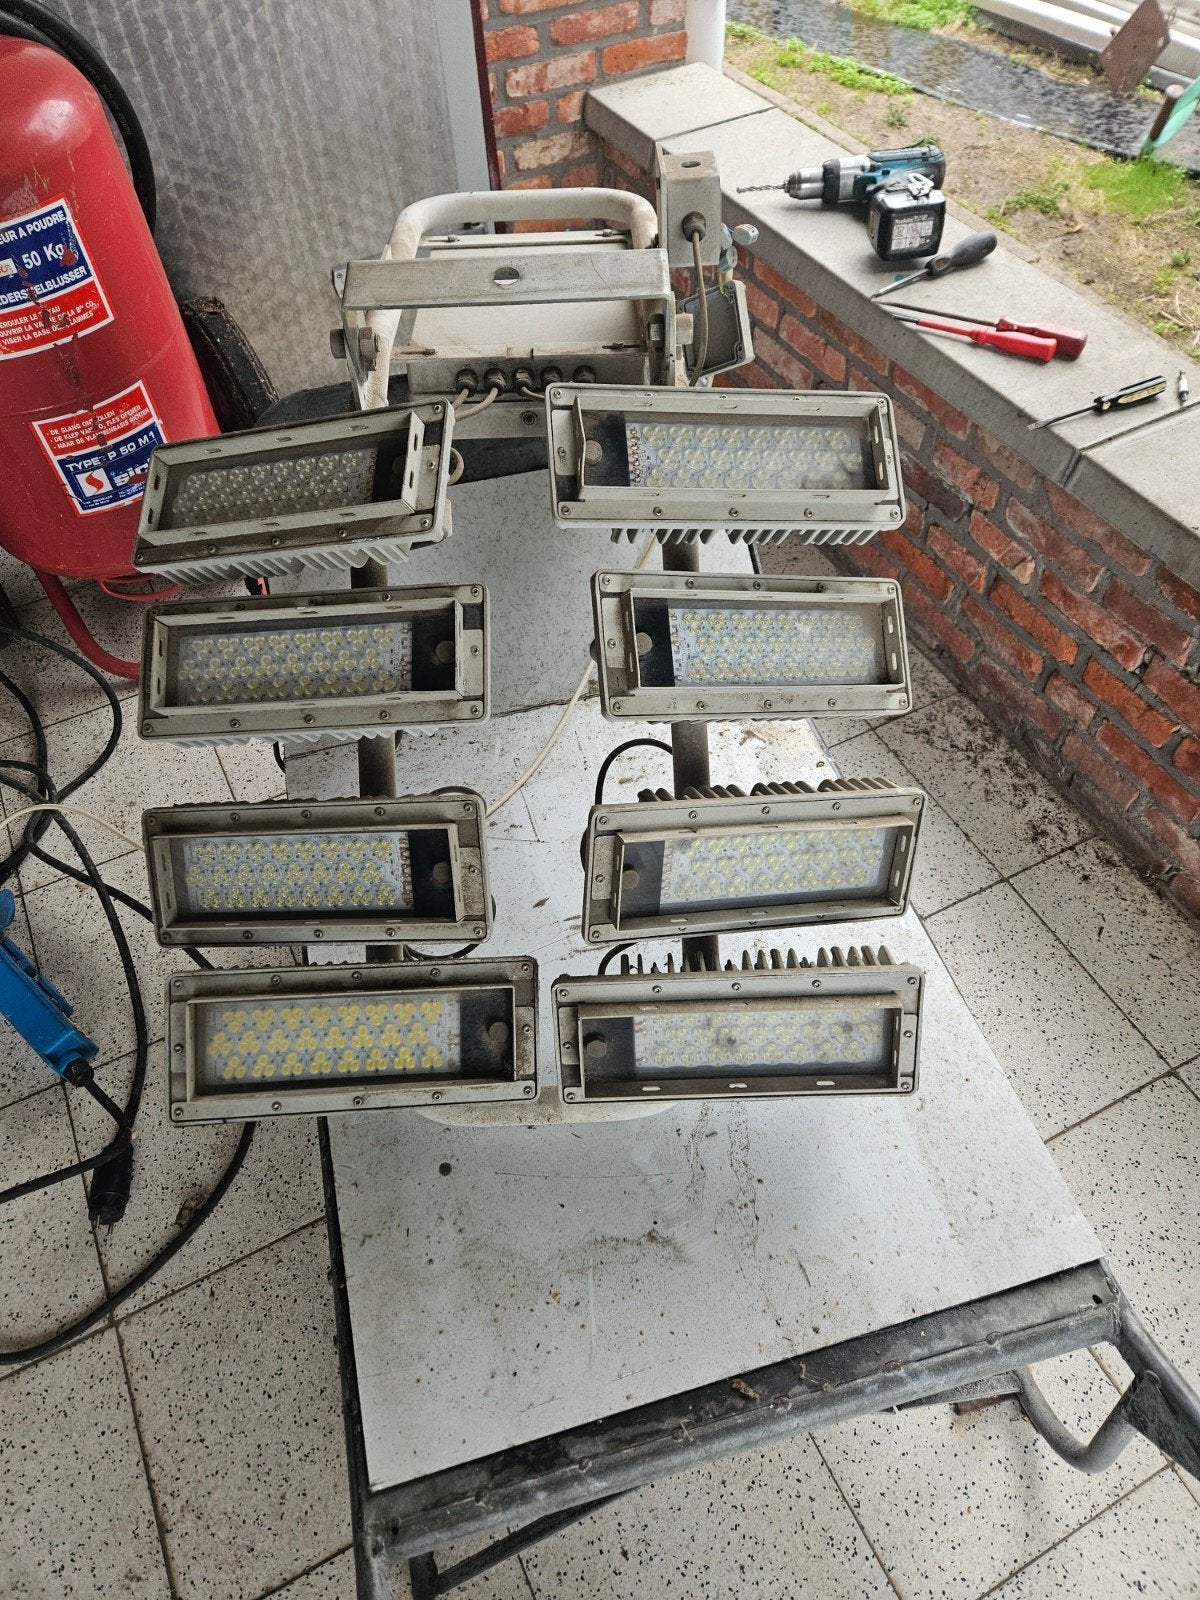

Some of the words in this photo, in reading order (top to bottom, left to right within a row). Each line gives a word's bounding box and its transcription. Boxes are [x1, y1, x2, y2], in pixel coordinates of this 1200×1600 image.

[18, 227, 27, 238] A
[26, 210, 66, 235] POUDRE
[21, 250, 42, 270] 50
[43, 242, 65, 262] Kg
[0, 265, 88, 306] DERSELBLUSSER
[1, 337, 22, 345] VISER
[66, 310, 94, 327] LAMMES
[24, 324, 33, 332] LA
[67, 309, 76, 317] LA
[29, 313, 38, 321] LE
[38, 306, 61, 318] TYAU
[60, 423, 82, 434] SLANG
[82, 410, 115, 426] ONTOLLEN
[64, 432, 80, 440] KLEP
[106, 416, 121, 426] FLES
[120, 404, 141, 419] OPENEN
[86, 420, 129, 441] VLAMENBASIS
[130, 407, 149, 422] RICHTEN
[108, 451, 117, 461] P
[120, 442, 137, 455] 50
